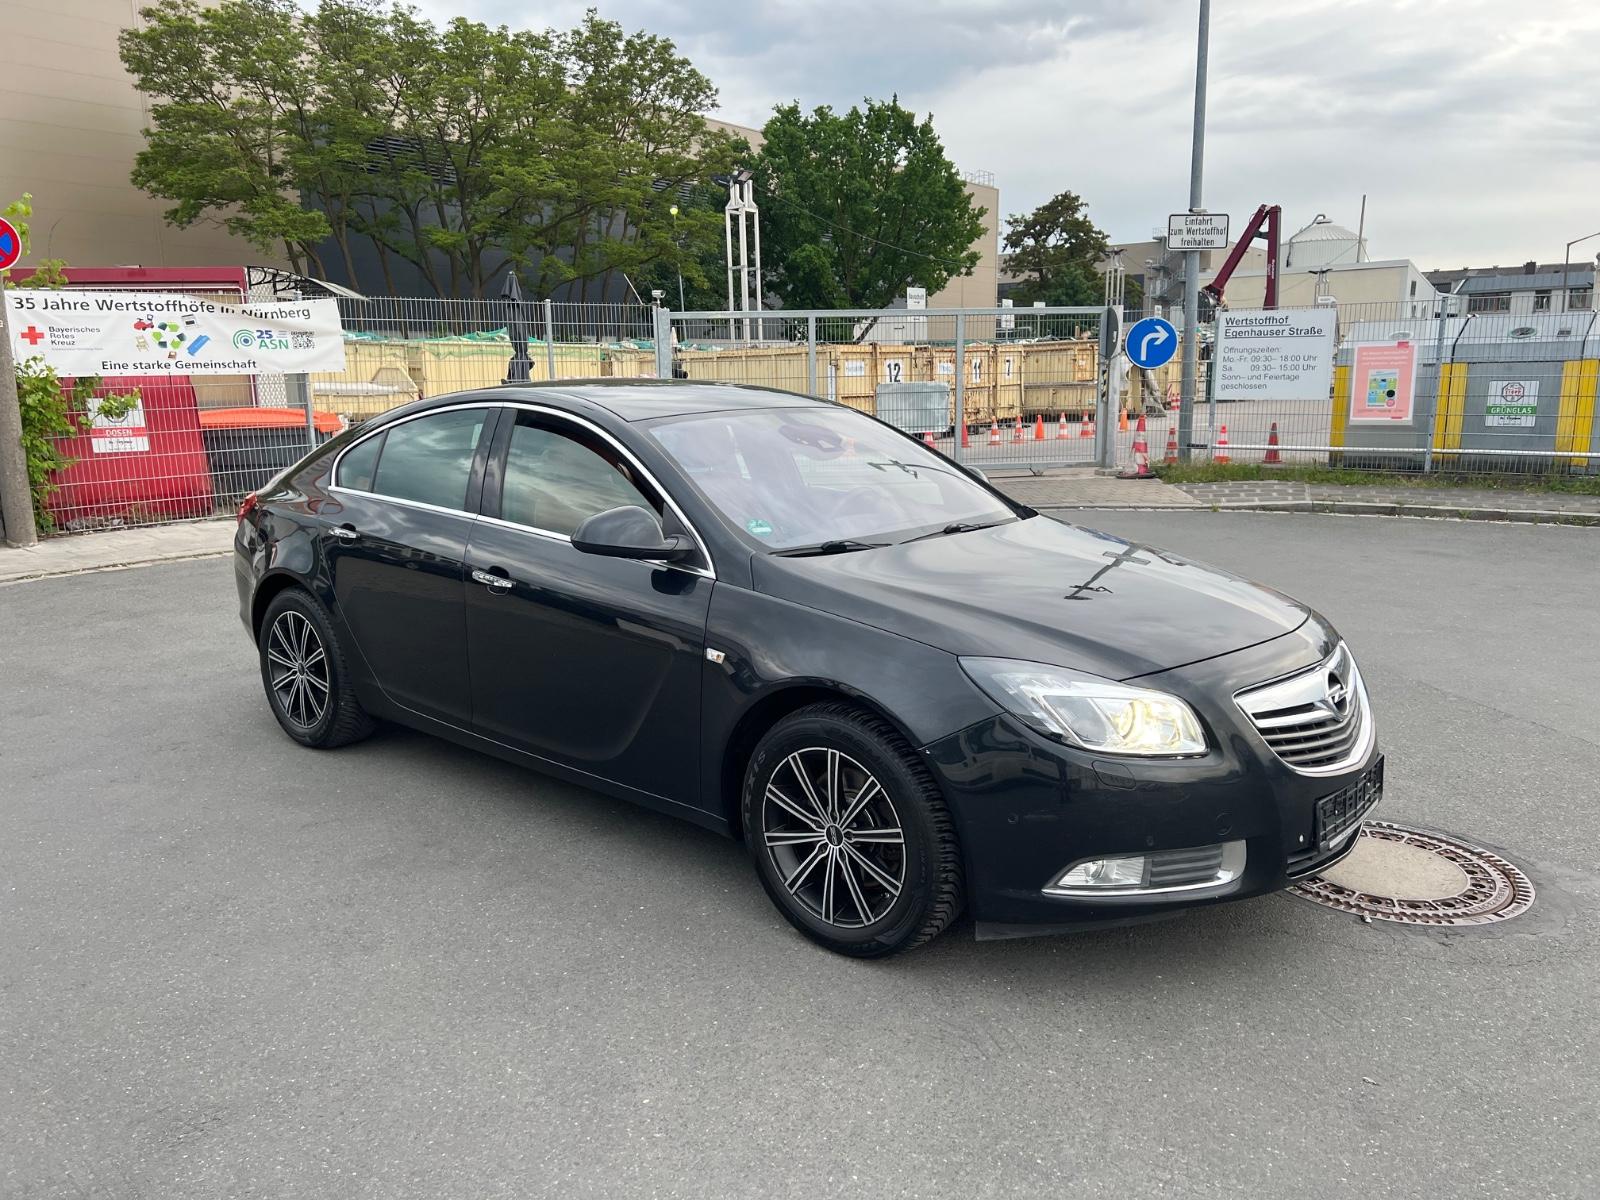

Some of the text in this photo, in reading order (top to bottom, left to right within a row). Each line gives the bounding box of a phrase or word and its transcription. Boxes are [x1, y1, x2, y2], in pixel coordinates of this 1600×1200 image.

[1184, 217, 1213, 226] Einfahrt
[1170, 226, 1227, 236] zum Wertstoffhof
[1180, 237, 1215, 247] freihalten
[13, 297, 36, 310] 35
[42, 297, 90, 311] Jahre
[95, 298, 216, 313] Wertstoffhöfe
[241, 307, 311, 320] Nürnberg
[1225, 315, 1289, 325] Wertstoffhof
[48, 326, 101, 334] Bayerisches
[255, 329, 274, 340] 25
[1224, 326, 1323, 338] Egenhauser Straße
[258, 339, 290, 350] ASN
[1302, 354, 1318, 362] Uhr
[101, 359, 257, 370] Eine starke Gemeinschaft
[1005, 359, 1011, 376] 7
[1302, 363, 1318, 371] Uhr
[887, 362, 901, 383] 12
[973, 362, 981, 380] 11
[1247, 372, 1262, 381] und
[1263, 372, 1300, 382] Feiertage
[1220, 382, 1268, 391] geschlossen
[1490, 406, 1533, 414] GRÜNGLAS
[105, 429, 133, 437] DOSEN
